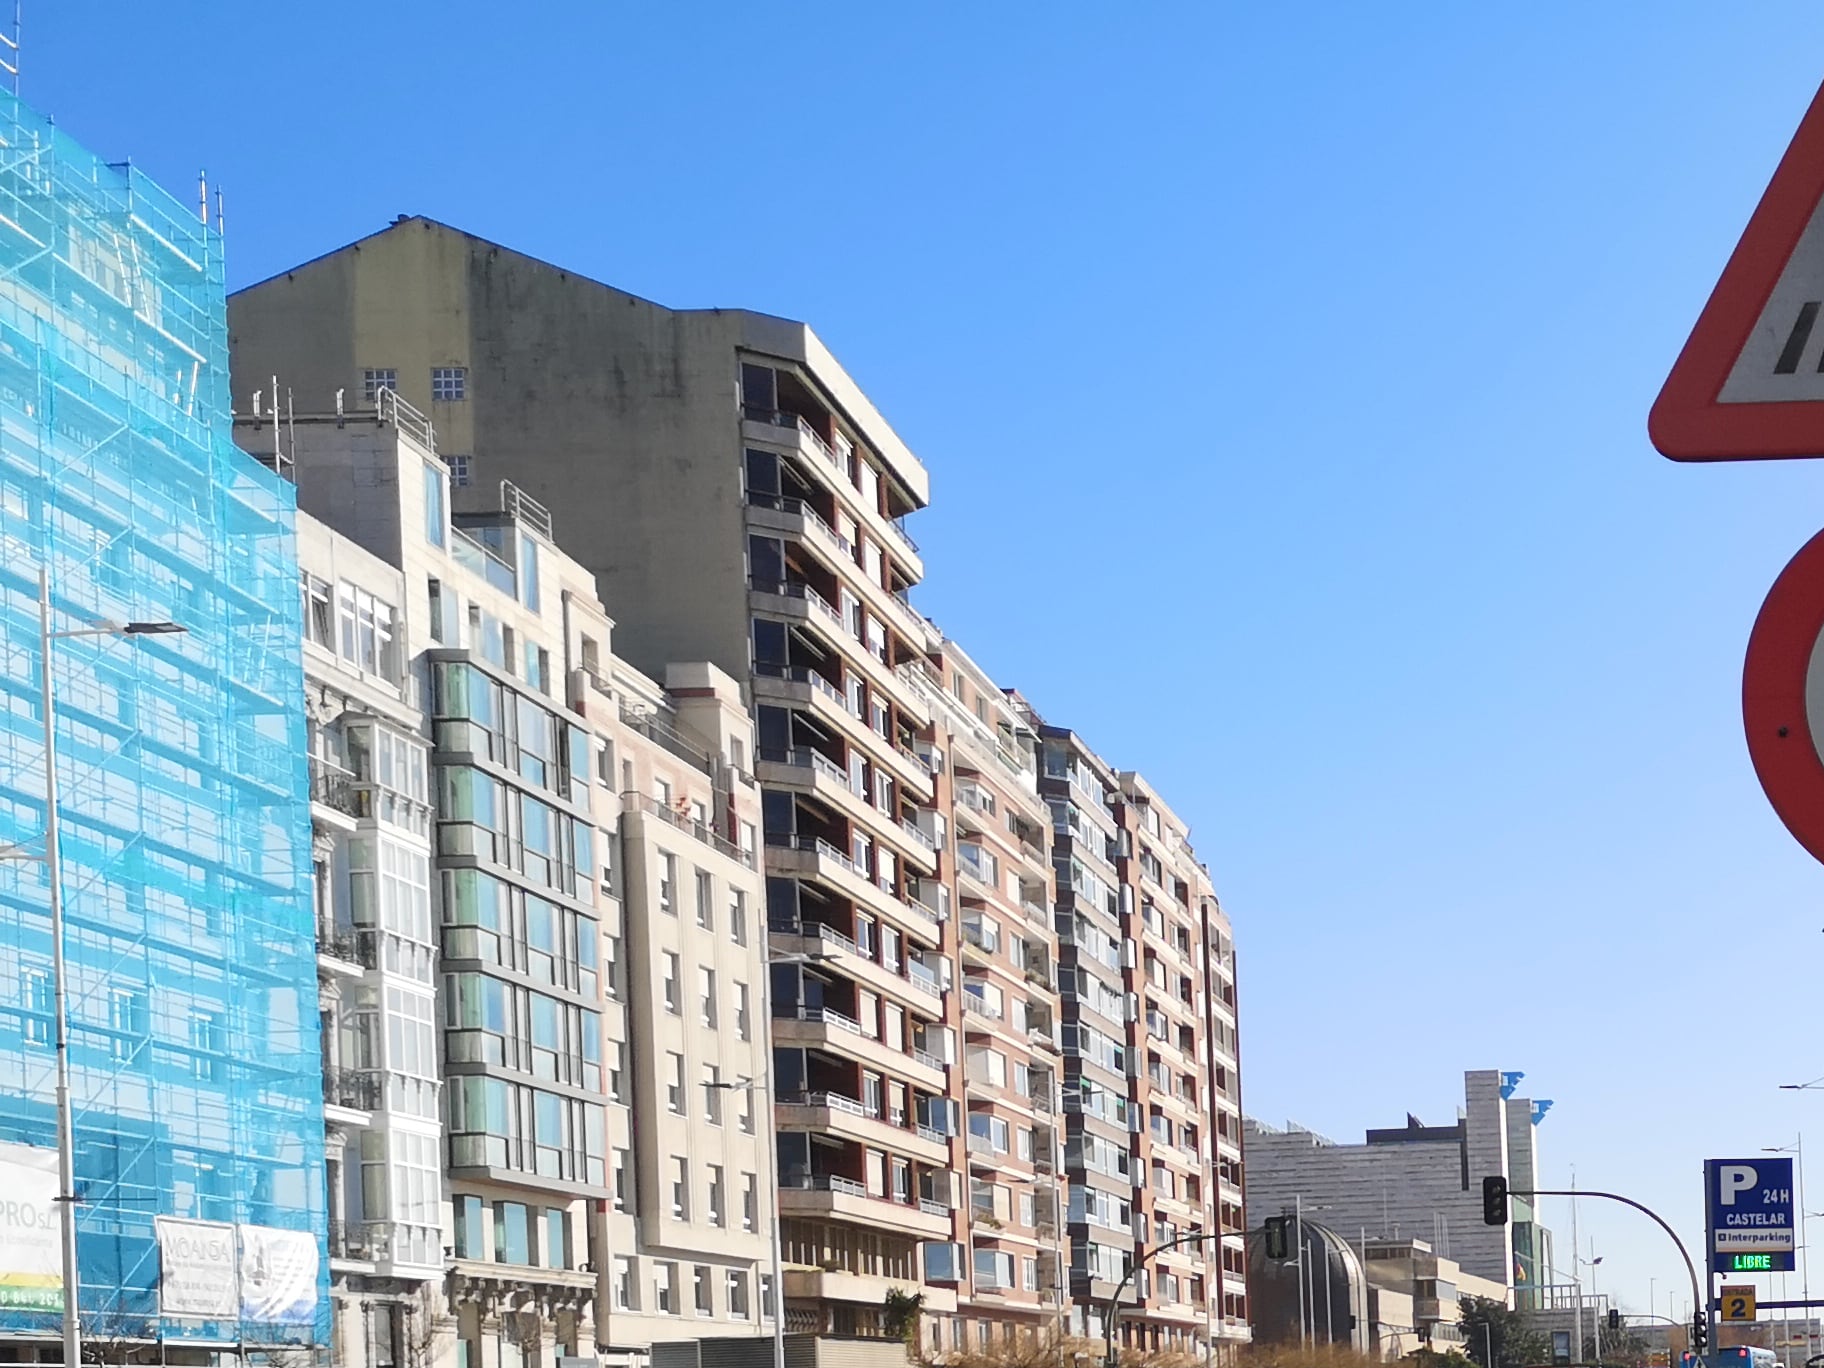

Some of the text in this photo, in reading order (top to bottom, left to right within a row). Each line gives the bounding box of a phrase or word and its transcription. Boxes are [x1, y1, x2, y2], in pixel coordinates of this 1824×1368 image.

[1720, 1165, 1758, 1206] P
[1763, 1188, 1790, 1204] 24 H
[1726, 1213, 1786, 1226] CASTELAR
[1728, 1231, 1791, 1245] Interparking
[1734, 1255, 1772, 1270] LIBRE
[1731, 1298, 1746, 1318] 2
